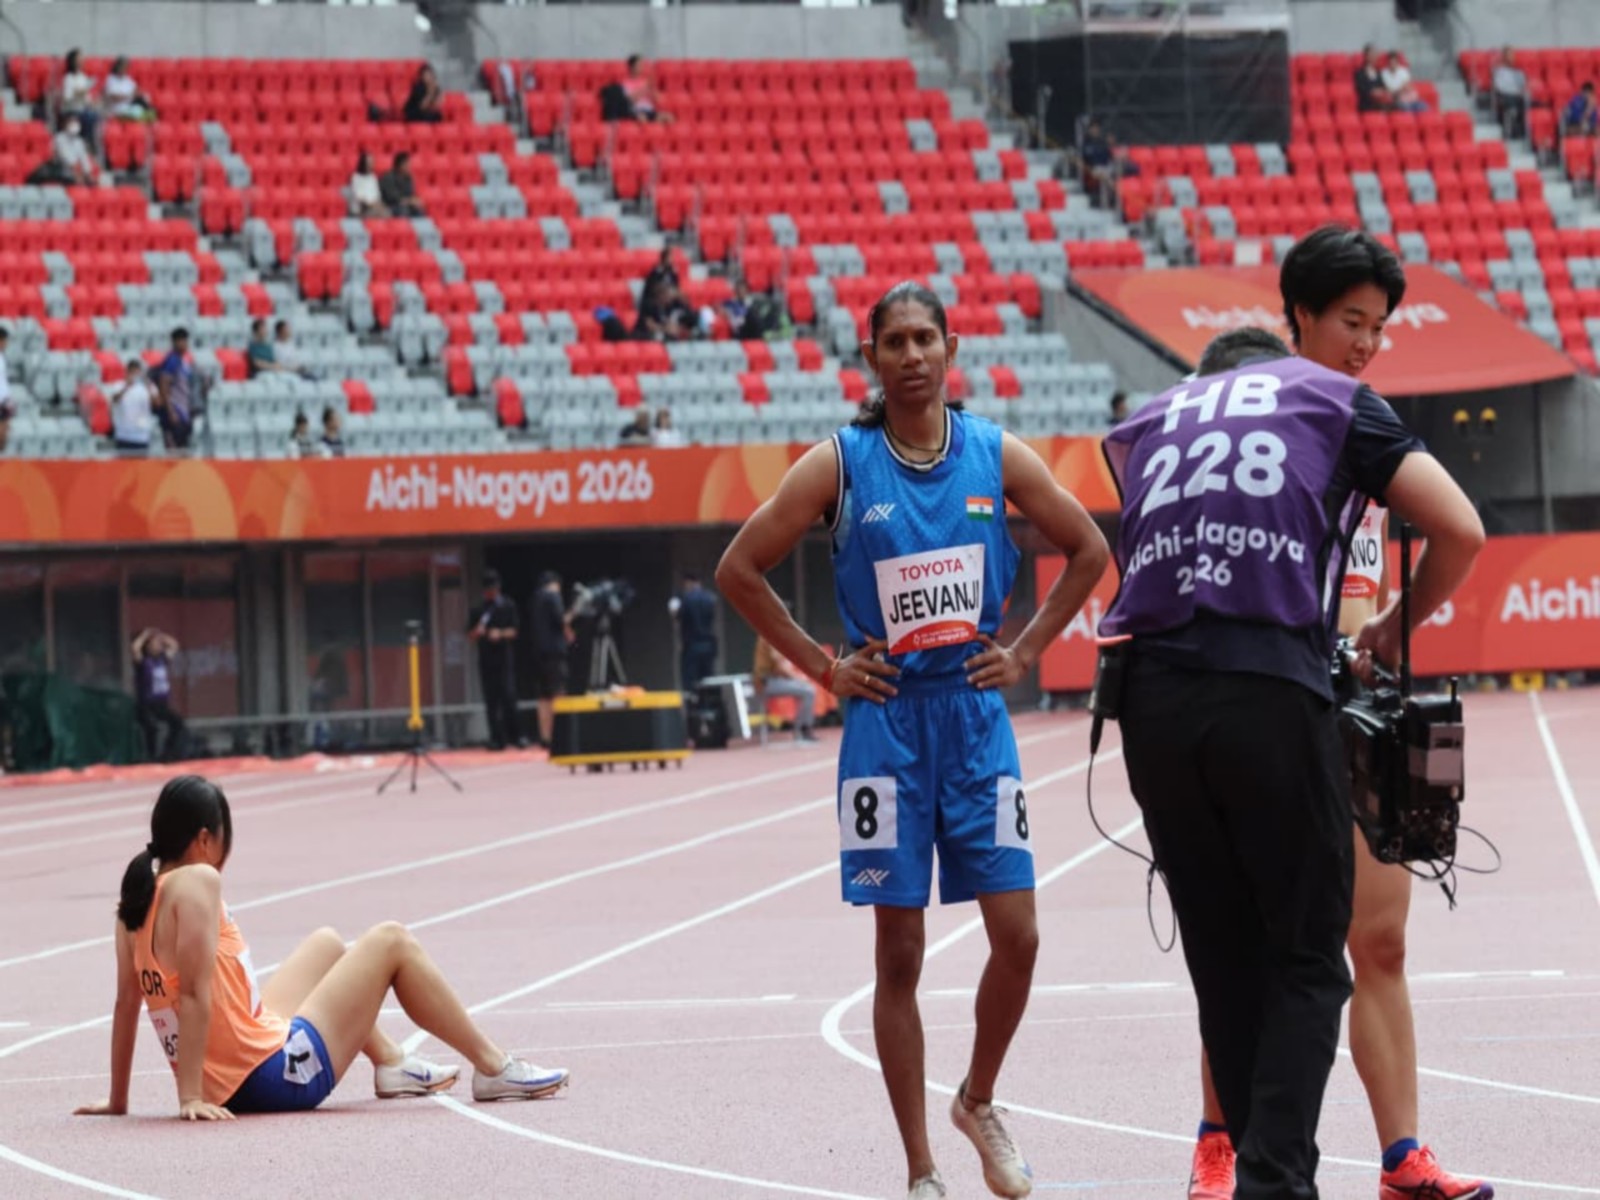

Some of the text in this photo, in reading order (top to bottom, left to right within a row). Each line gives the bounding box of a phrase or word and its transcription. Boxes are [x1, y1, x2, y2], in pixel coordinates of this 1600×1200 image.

[1162, 372, 1282, 434] HB
[365, 457, 654, 520] Aichi-Nagoya 2026
[1140, 430, 1288, 519] 228
[898, 557, 965, 582] TOYOTA
[1176, 553, 1233, 596] 226
[889, 579, 980, 625] JEEVANJI
[852, 785, 879, 840] 8
[1014, 788, 1030, 841] 8
[142, 968, 167, 998] OR
